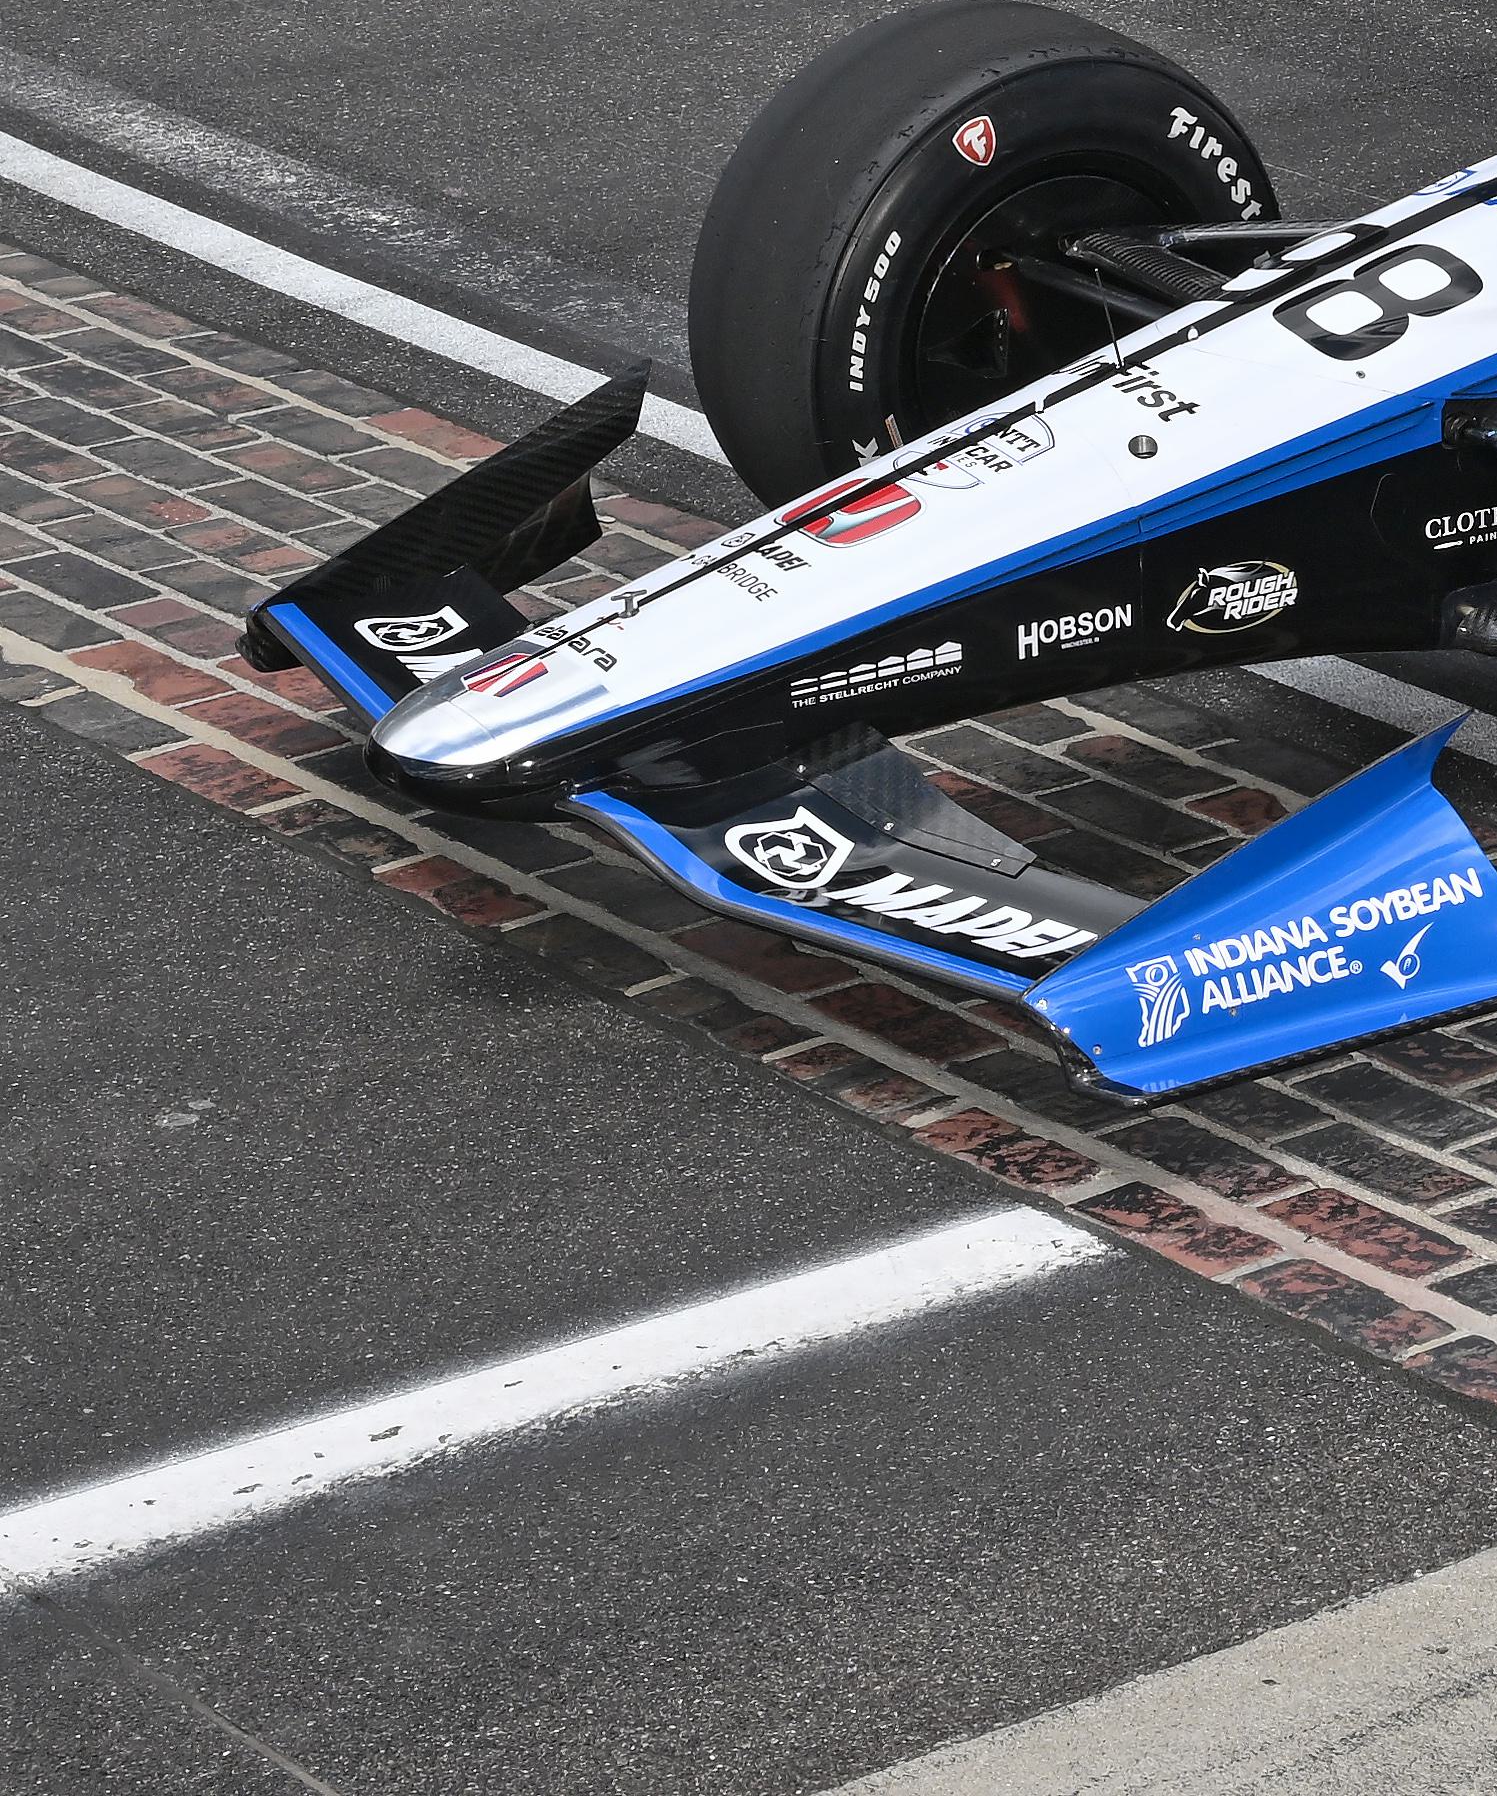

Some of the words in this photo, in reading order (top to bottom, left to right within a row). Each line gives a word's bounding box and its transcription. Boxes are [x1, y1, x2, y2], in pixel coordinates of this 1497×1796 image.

[1208, 570, 1297, 606] ROUGH
[1223, 587, 1299, 621] RIDER
[1018, 603, 1133, 660] HOBSON
[792, 694, 816, 709] THE
[818, 678, 900, 704] STELLRECHT
[902, 665, 963, 685] COMPANY
[830, 872, 1098, 958] MAPEI
[1184, 915, 1329, 978] INDIANA
[1329, 867, 1485, 939] SOYBEAN
